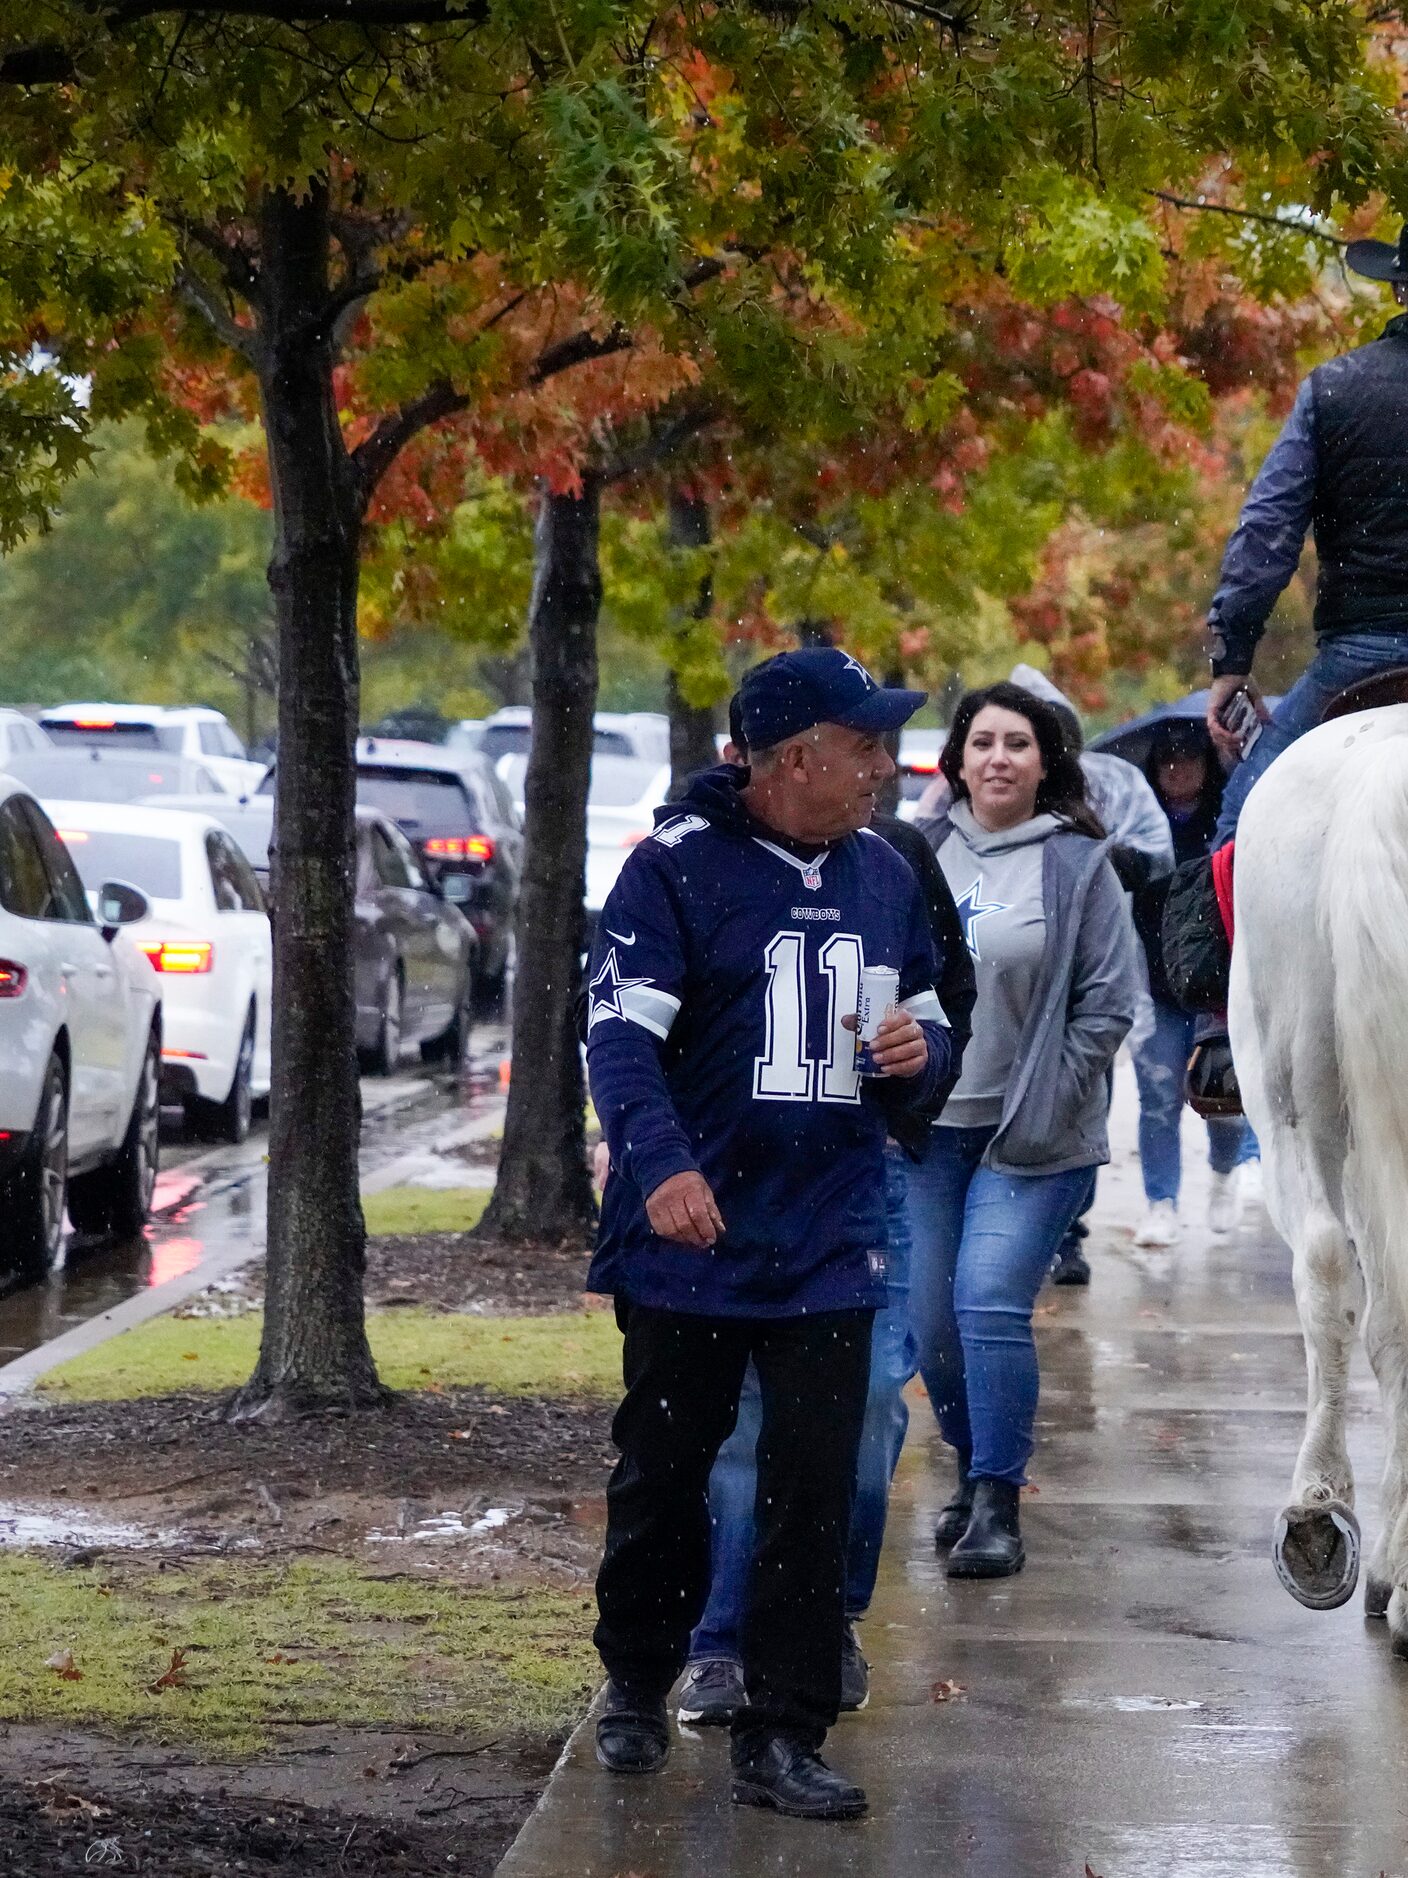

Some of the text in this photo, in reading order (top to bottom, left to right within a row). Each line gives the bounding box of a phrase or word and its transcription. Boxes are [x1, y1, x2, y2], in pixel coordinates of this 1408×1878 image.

[791, 907, 841, 921] COWBOYS
[752, 930, 865, 1104] 11
[862, 997, 871, 1024] Extra
